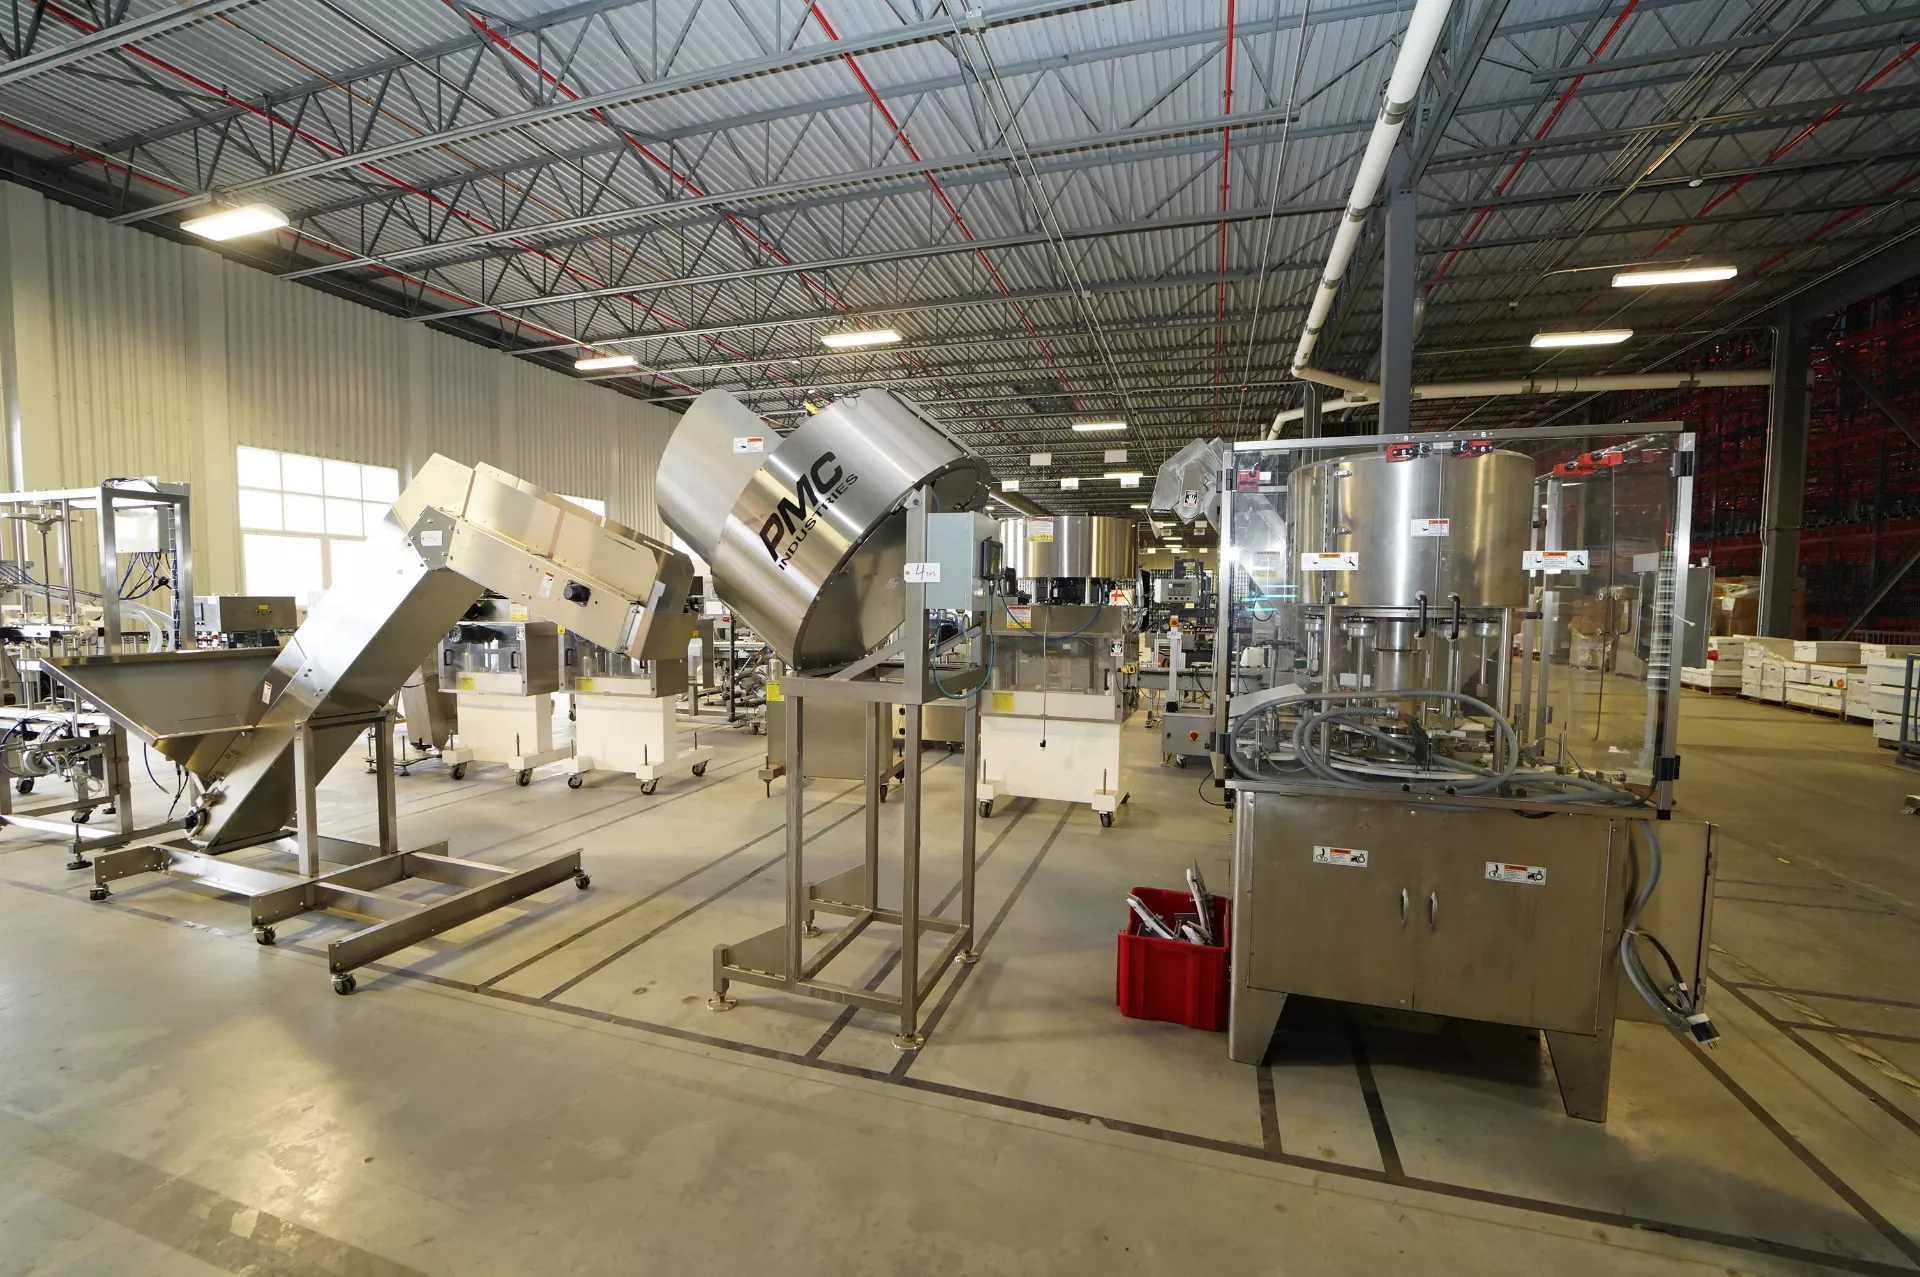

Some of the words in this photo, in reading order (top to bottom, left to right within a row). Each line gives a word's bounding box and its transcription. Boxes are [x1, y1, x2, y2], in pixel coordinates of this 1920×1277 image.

[759, 451, 843, 562] PMC
[778, 473, 858, 570] INDUSTRIES
[915, 563, 924, 581] 4
